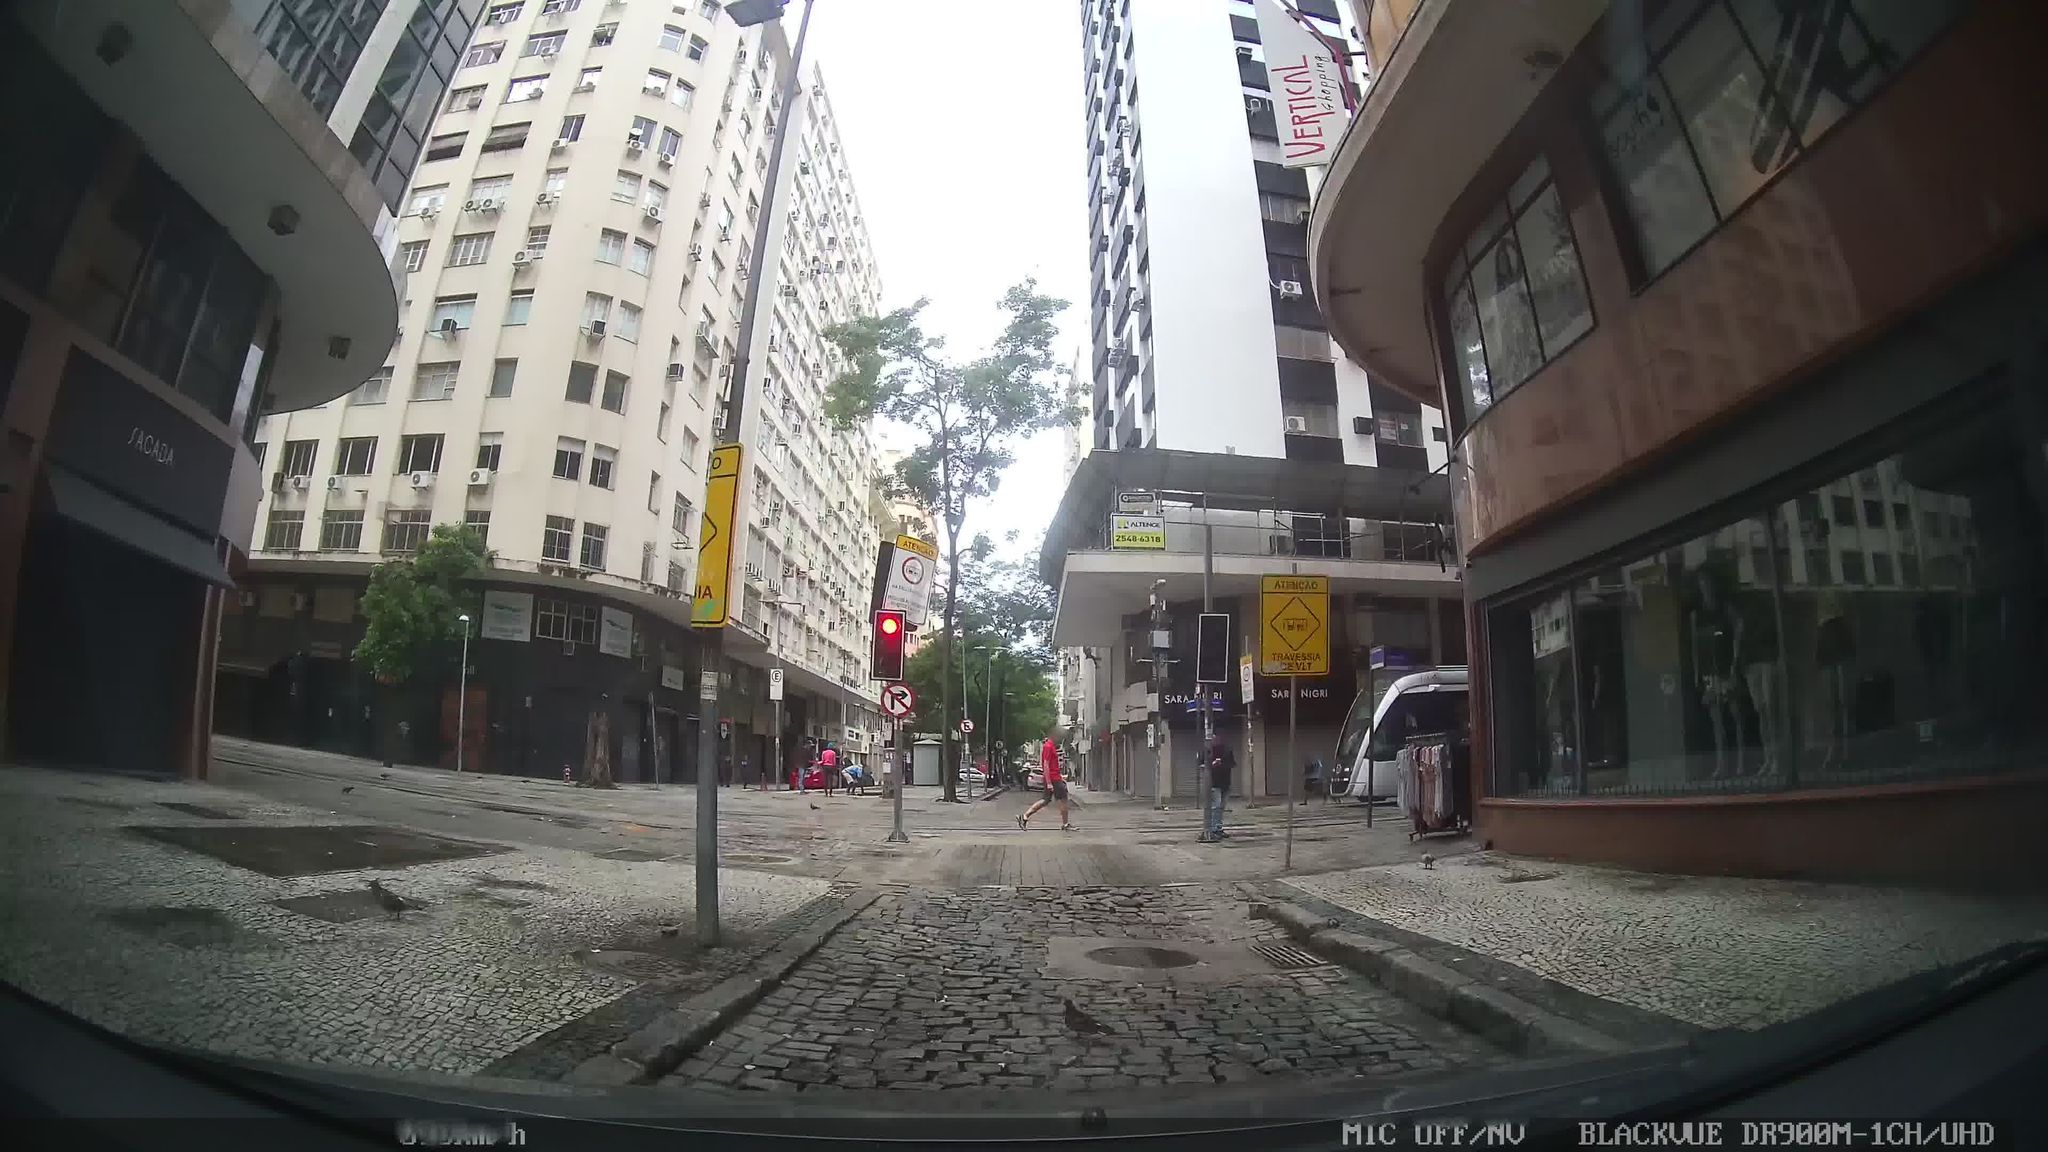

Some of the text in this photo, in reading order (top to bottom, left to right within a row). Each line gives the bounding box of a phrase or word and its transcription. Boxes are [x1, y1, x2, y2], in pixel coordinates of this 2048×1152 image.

[1314, 55, 1338, 112] shopping
[1271, 54, 1335, 158] VERTICAL
[1116, 534, 1162, 543] 2548-6318
[1272, 652, 1321, 661] TRAVESSIA
[1296, 662, 1312, 671] VLT
[1164, 694, 1189, 703] SARA
[1271, 689, 1328, 699] SAR NIGRI
